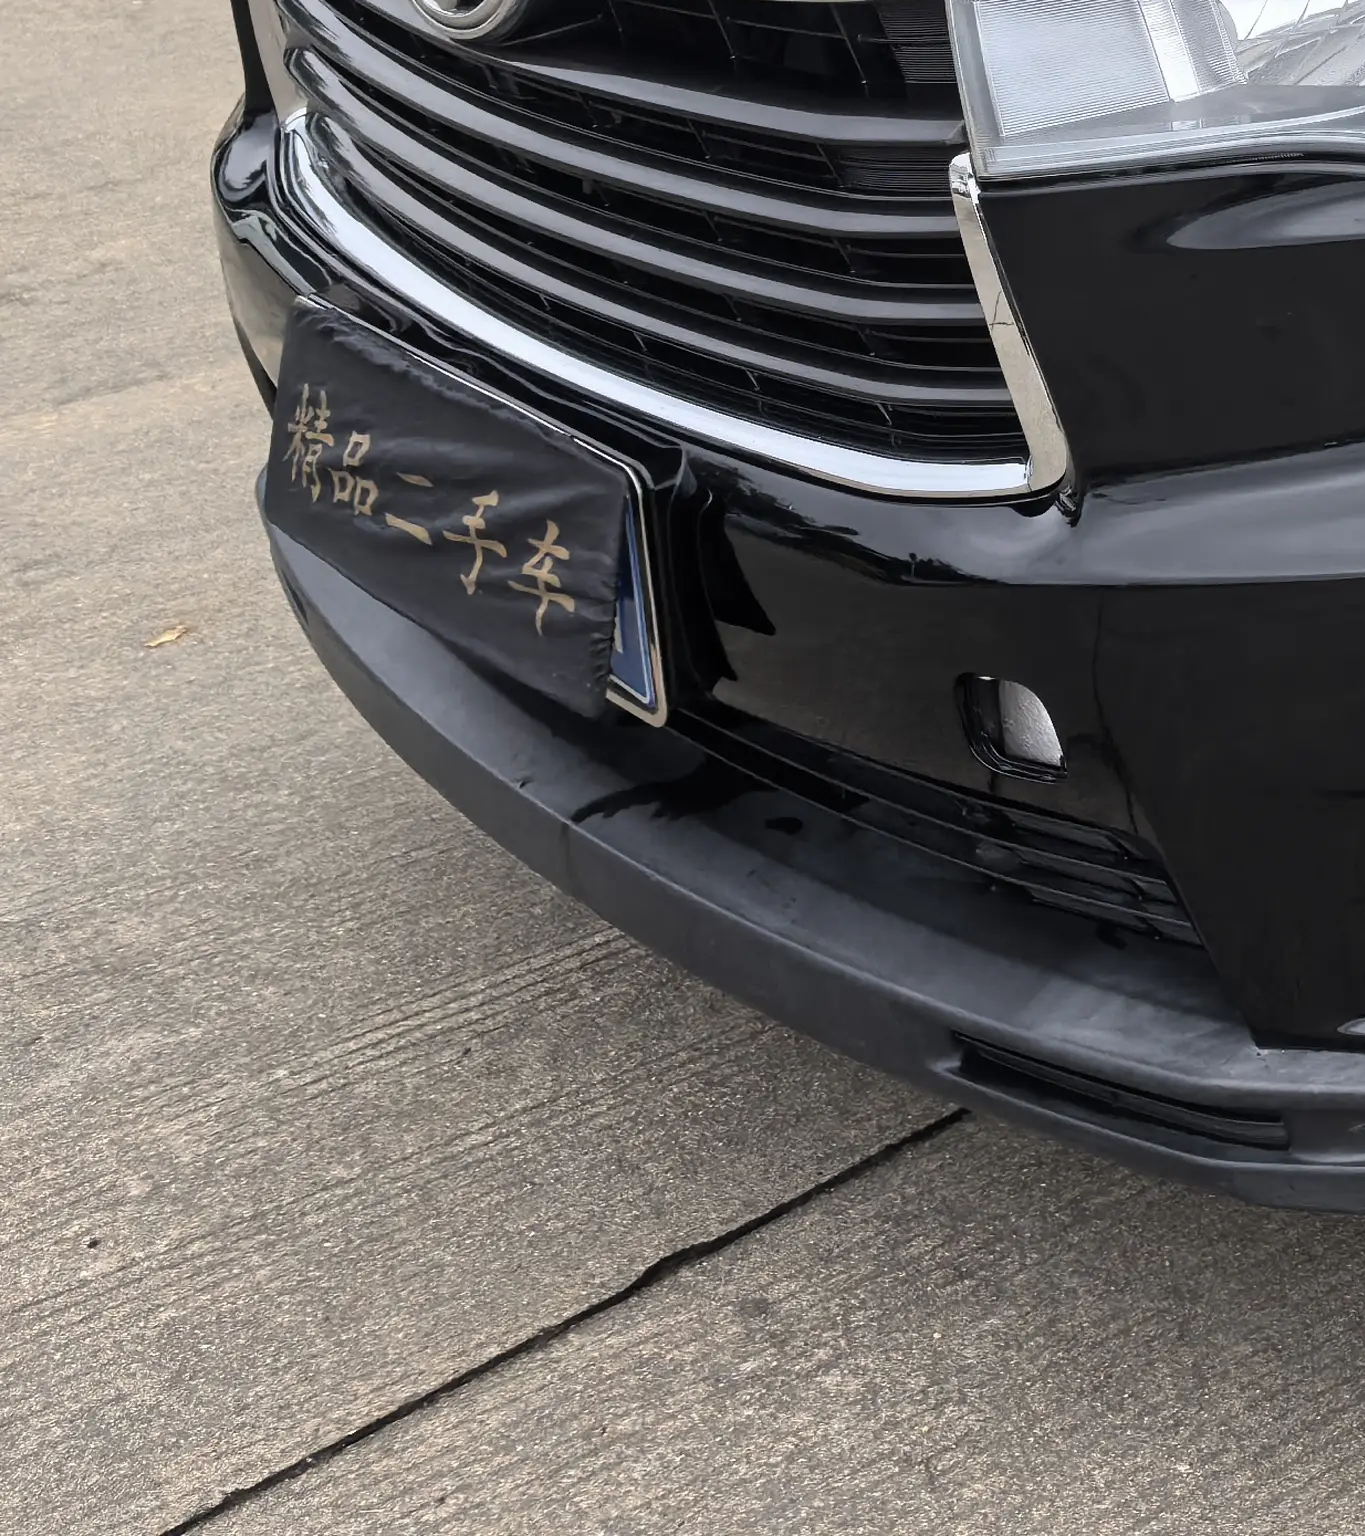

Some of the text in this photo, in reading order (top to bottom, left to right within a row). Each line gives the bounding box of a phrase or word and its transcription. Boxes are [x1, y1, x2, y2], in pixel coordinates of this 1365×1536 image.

[281, 382, 576, 638] 精品二手车
